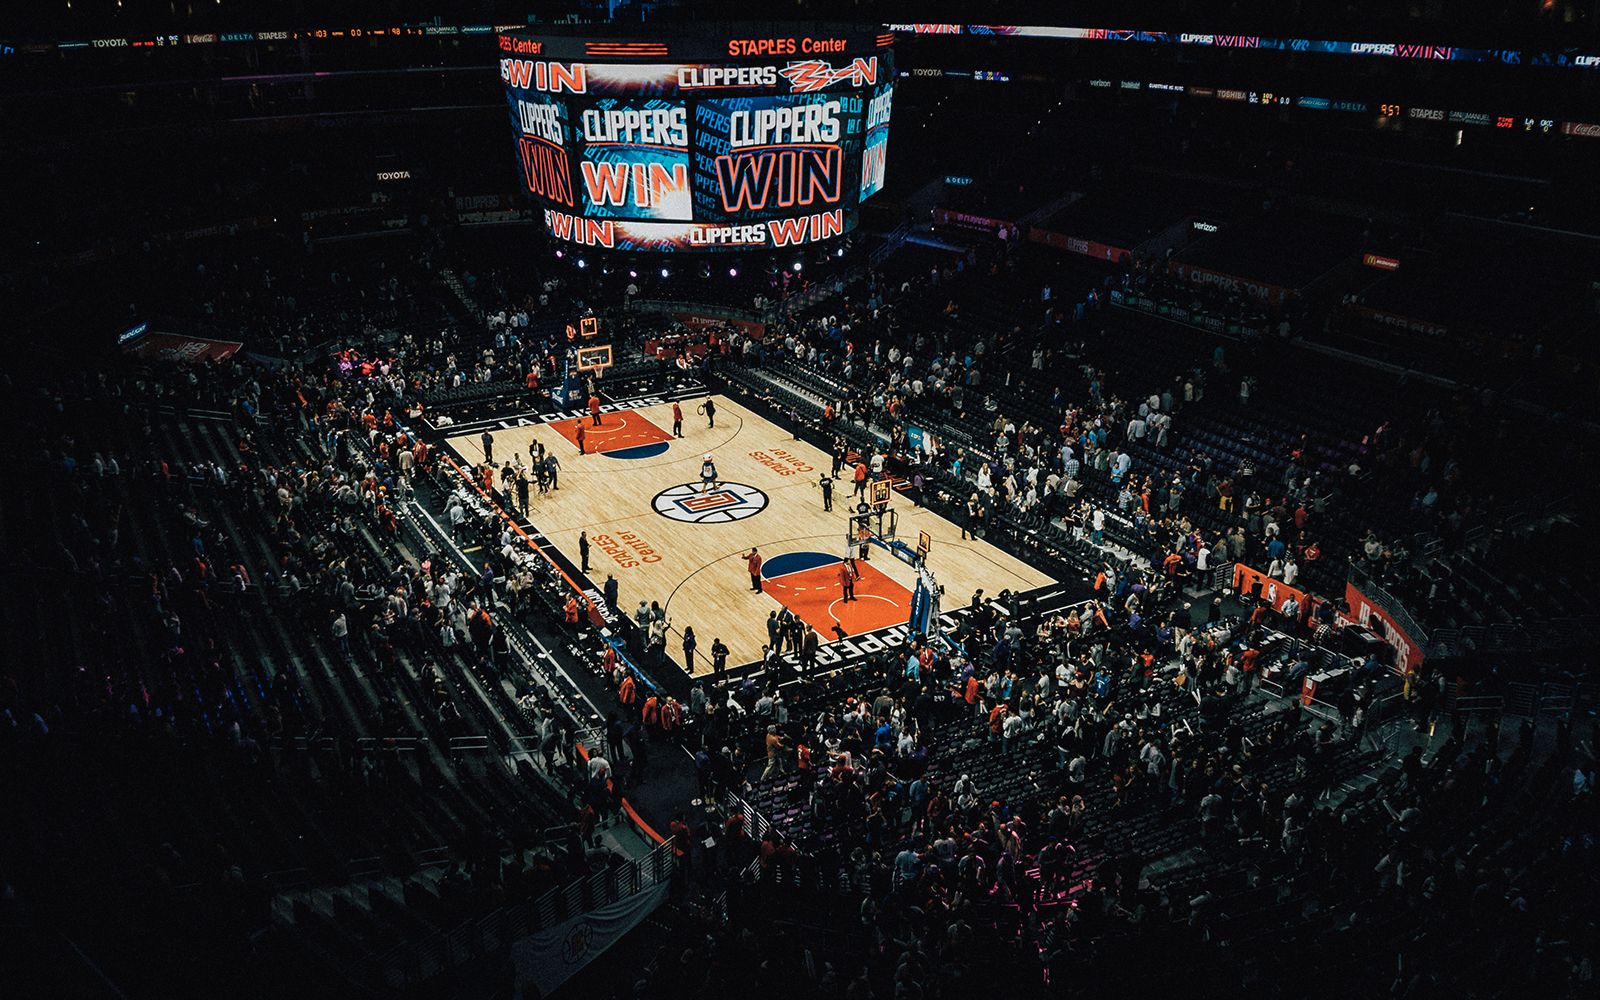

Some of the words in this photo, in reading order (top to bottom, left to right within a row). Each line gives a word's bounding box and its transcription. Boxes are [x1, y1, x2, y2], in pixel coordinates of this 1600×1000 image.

[227, 33, 253, 41] DELTA
[258, 32, 288, 40] STAPLES
[913, 23, 960, 34] WIN
[92, 38, 128, 48] TOYOTA
[512, 37, 543, 54] Center
[728, 39, 796, 56] STAPLES
[801, 37, 847, 53] Center
[1181, 33, 1213, 44] CLIPPERS
[1213, 34, 1260, 48] WIN
[1351, 42, 1395, 54] CLIPPERS
[1395, 43, 1452, 60] WIN
[508, 58, 587, 94] WIN
[677, 66, 777, 87] CLIPPERS
[913, 69, 942, 77] TOYOTA
[1090, 80, 1111, 88] verizon
[1217, 89, 1247, 100] TOSHIBA
[1341, 102, 1368, 112] DELTA
[1411, 107, 1444, 120] STAPLES
[518, 100, 563, 146] CLIPPERS
[583, 107, 689, 147] CLIPPERS
[731, 100, 841, 147] CLIPPERS
[376, 171, 410, 181] TOYOTA
[519, 138, 574, 208] WIN
[714, 148, 843, 213] WIN
[580, 161, 687, 208] WIN
[551, 209, 614, 248] WIN
[690, 223, 766, 244] CLIPPERS
[768, 208, 843, 247] WIN
[1193, 221, 1218, 233] verizon
[498, 417, 536, 430] LA
[748, 451, 796, 476] STAPLES
[768, 448, 814, 473] Center
[591, 534, 640, 569] STAPLES
[616, 530, 662, 564] Center
